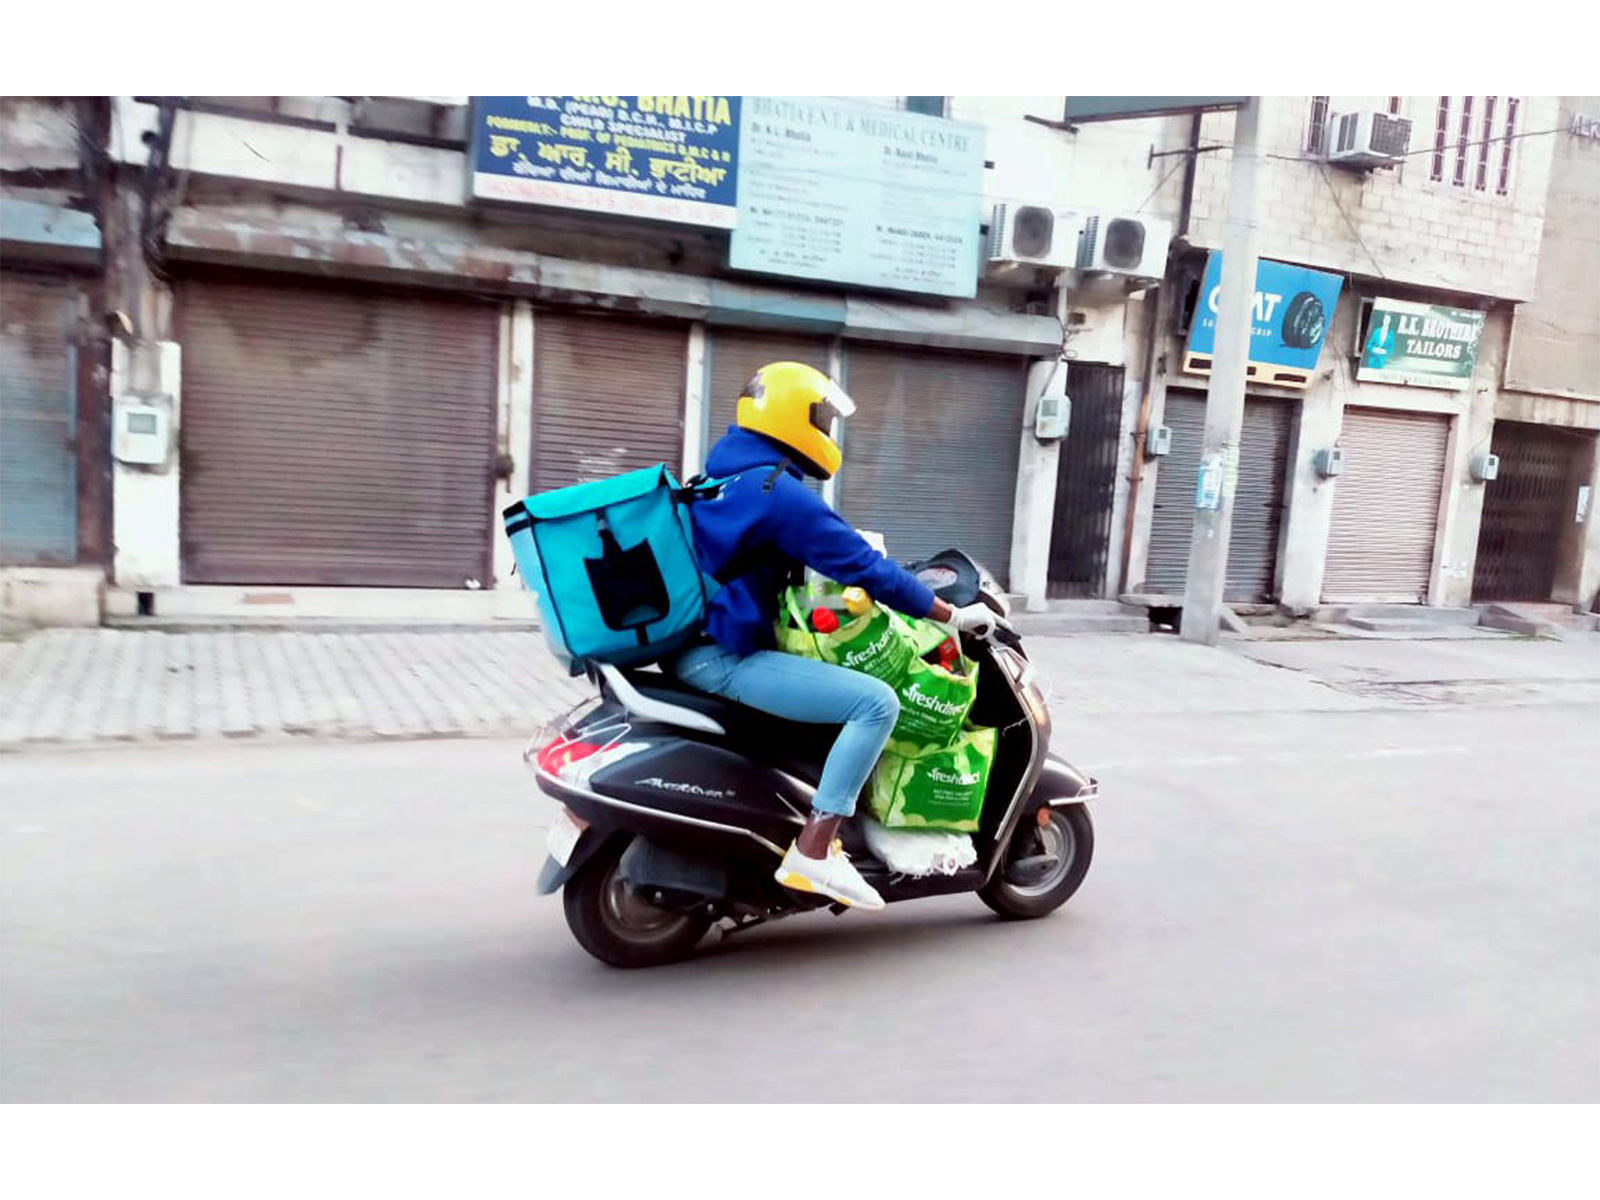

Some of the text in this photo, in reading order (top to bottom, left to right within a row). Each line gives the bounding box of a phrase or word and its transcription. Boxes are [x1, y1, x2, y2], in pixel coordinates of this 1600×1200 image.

[607, 121, 687, 143] SPECIALIST
[1208, 285, 1282, 322] CAT
[1406, 339, 1462, 359] TAILORS
